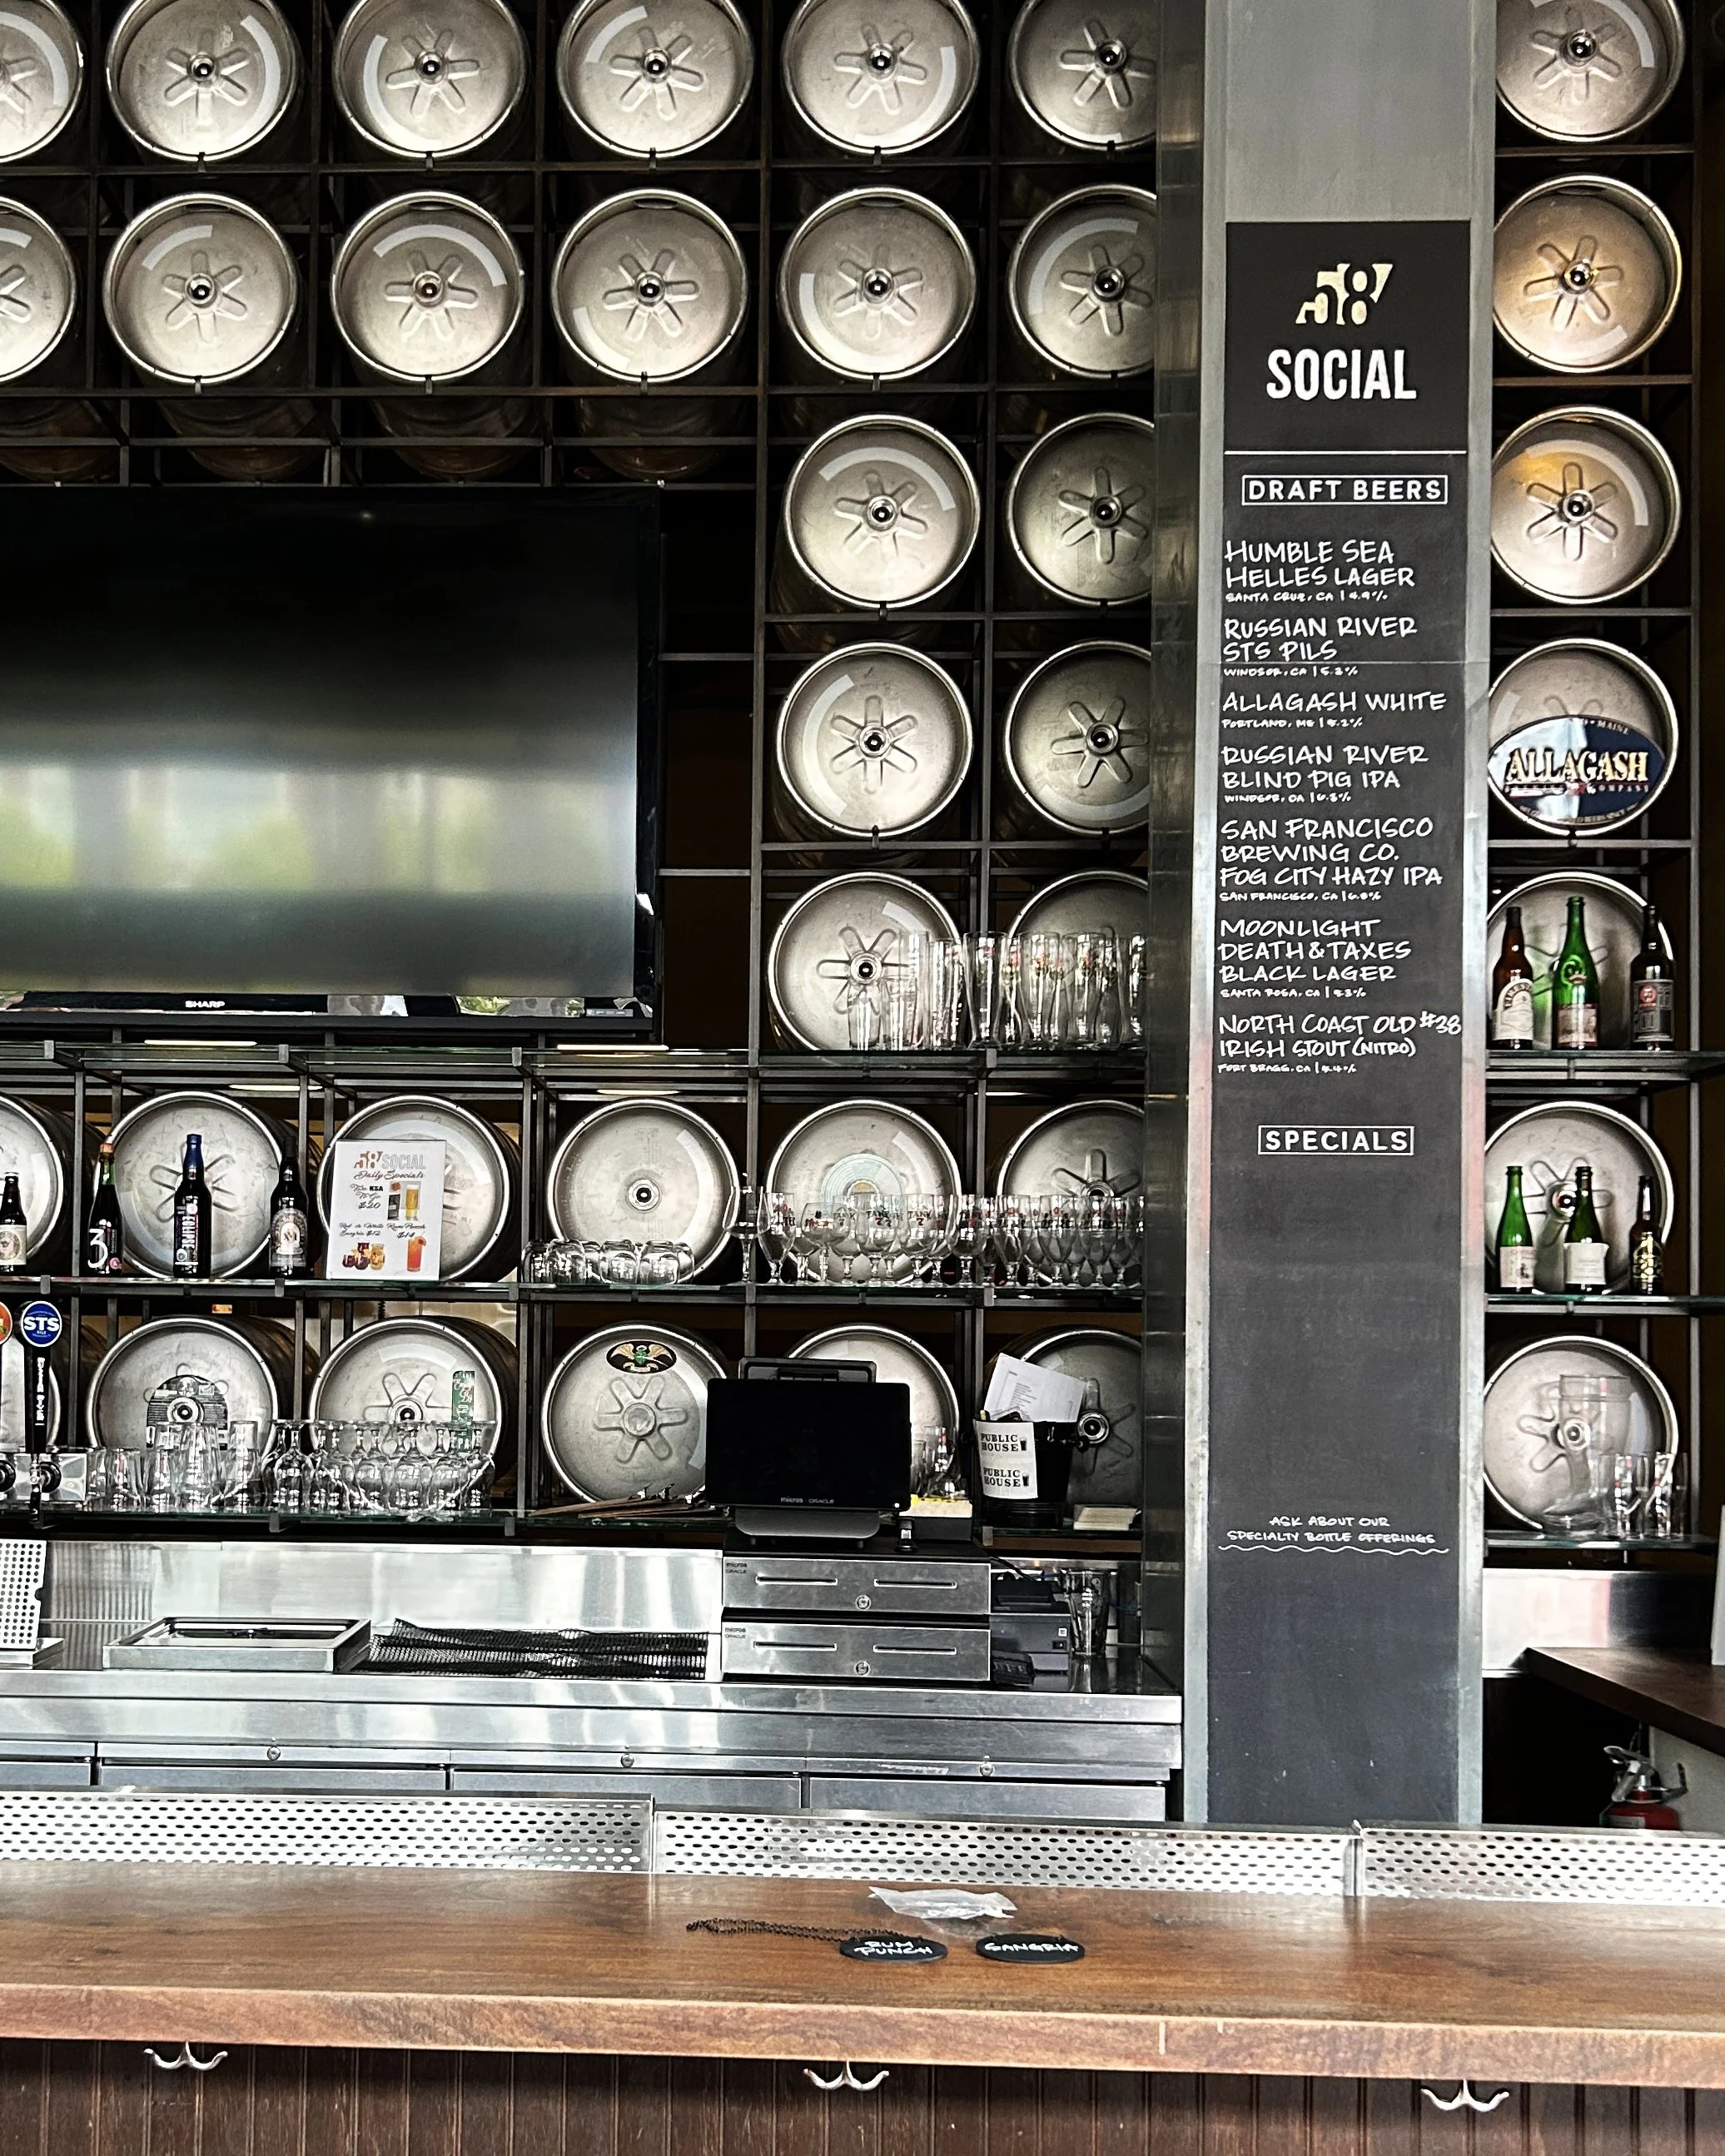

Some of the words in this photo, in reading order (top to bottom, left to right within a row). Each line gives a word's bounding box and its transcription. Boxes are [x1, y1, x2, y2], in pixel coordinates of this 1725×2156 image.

[1267, 349, 1416, 400] SOCIAL
[1250, 480, 1341, 500] DRAFT
[1354, 480, 1440, 499] BEERS
[1225, 540, 1333, 564] HUMBLE
[1342, 539, 1394, 564] SEA
[1226, 566, 1327, 588] HELLES
[1335, 568, 1414, 586] LAGER
[1225, 593, 1269, 602] SANTA
[1316, 592, 1333, 601] CA
[1225, 618, 1326, 639] RUSSIAN
[1337, 617, 1417, 637] RIVER
[1223, 642, 1270, 661] STS
[1279, 640, 1337, 661] PILS
[1290, 668, 1306, 676] CA
[1223, 692, 1356, 712] ALLAGASH
[1365, 692, 1446, 711] WHITE
[1221, 719, 1291, 728] PORTLAND,
[1221, 746, 1332, 765] RUSSIAN
[1343, 745, 1429, 765] RIVER
[1506, 748, 1648, 782] ALLAGASH
[1222, 772, 1301, 788] BLIND
[1308, 770, 1351, 788] PIG
[1362, 771, 1400, 787] IPA
[1289, 794, 1305, 802] CA
[1221, 820, 1276, 840] SAN
[1285, 817, 1433, 840] FRANCISCO
[1220, 843, 1349, 862] BREWING
[1360, 843, 1399, 862] CO.
[1220, 867, 1266, 887] FOG
[1275, 867, 1326, 886] CITY
[1332, 867, 1394, 886] HAZY
[1404, 867, 1442, 886] IPA
[1220, 892, 1247, 901] SAN
[1250, 892, 1318, 901] FRANCISCO,
[1221, 920, 1380, 937] MOONLIGHT
[1217, 941, 1304, 961] DEATH
[1327, 941, 1411, 960] TAXES
[1219, 966, 1306, 983] BLACK
[1313, 966, 1396, 981] LAGER
[1220, 989, 1260, 998] SANTA
[1220, 1015, 1295, 1034] NORTH
[1301, 1014, 1370, 1035] COAST
[1373, 1016, 1416, 1034] OLD
[1419, 1011, 1462, 1035] #38
[1220, 1040, 1285, 1058] IRISH
[1292, 1040, 1350, 1056] STOUT
[1352, 1037, 1415, 1056] (NITRO)
[1218, 1064, 1246, 1073] FORT
[1266, 1130, 1407, 1151] SPECIALS
[382, 1154, 426, 1170] SOCIAL
[354, 1170, 383, 1180] Daily
[384, 1170, 425, 1180] Specials
[181, 1215, 196, 1249] ECLIPSE
[87, 1228, 108, 1269] 3
[24, 1316, 60, 1332] STS
[981, 1433, 1018, 1443] PUBLIC
[982, 1443, 1018, 1453] HOUSE
[983, 1468, 1021, 1478] PUBLIC
[984, 1478, 1021, 1488] HOUSE
[1270, 1516, 1303, 1526] ASK
[1308, 1516, 1355, 1526] ABOUT
[1359, 1518, 1389, 1526] OUR
[1227, 1531, 1299, 1541] SPECIALTY
[1305, 1533, 1351, 1542] BOTTLE
[1358, 1533, 1435, 1543] OFFERINGS
[854, 1946, 932, 1955] PUNCH
[864, 1940, 914, 1949] RUM
[984, 1942, 1079, 1952] SANGRIA
